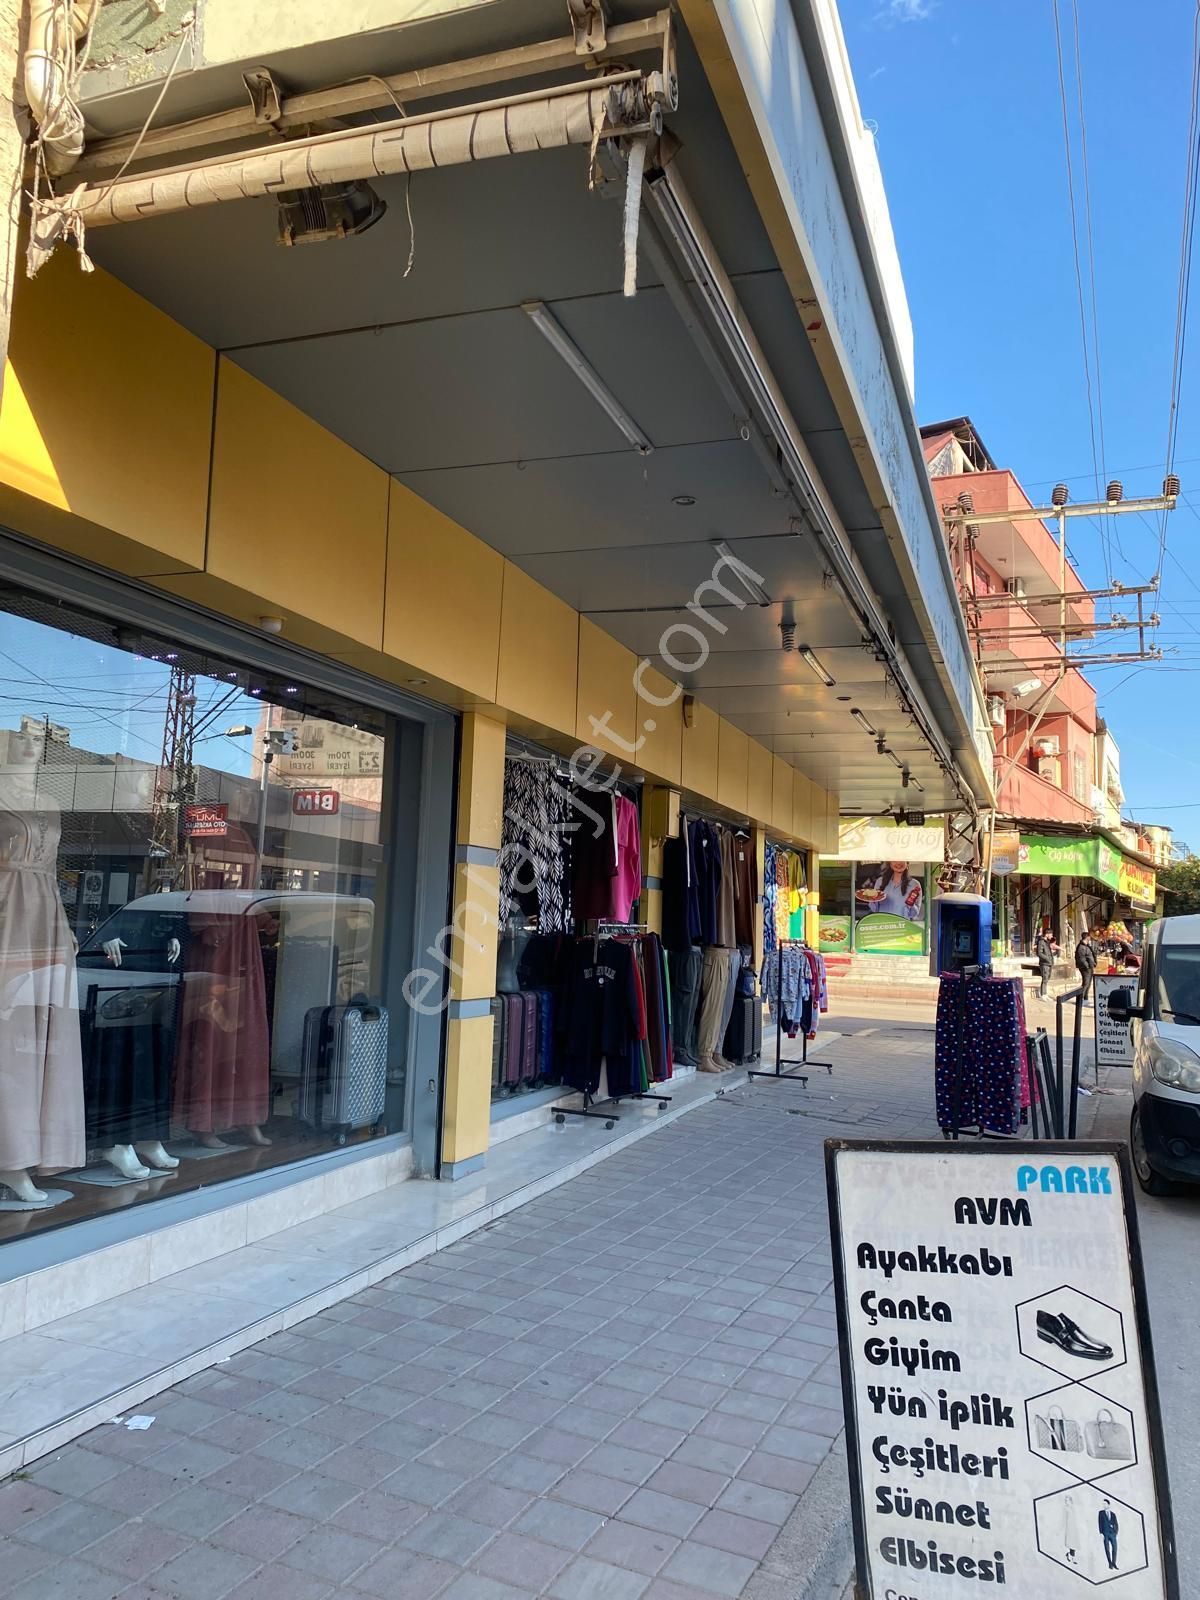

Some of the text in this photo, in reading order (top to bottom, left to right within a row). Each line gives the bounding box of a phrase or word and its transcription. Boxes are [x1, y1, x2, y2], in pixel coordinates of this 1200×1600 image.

[1016, 1164, 1113, 1197] PARK
[954, 1196, 1033, 1227] AVM
[856, 1241, 1014, 1279] Ayakkabı
[860, 1290, 953, 1327] Çanta
[863, 1336, 962, 1377] Giyim
[867, 1384, 1016, 1431] Yün iplik
[871, 1435, 1010, 1480] Çeşitleri
[875, 1485, 992, 1531] Sünnet
[878, 1535, 1007, 1585] Elbisesi
